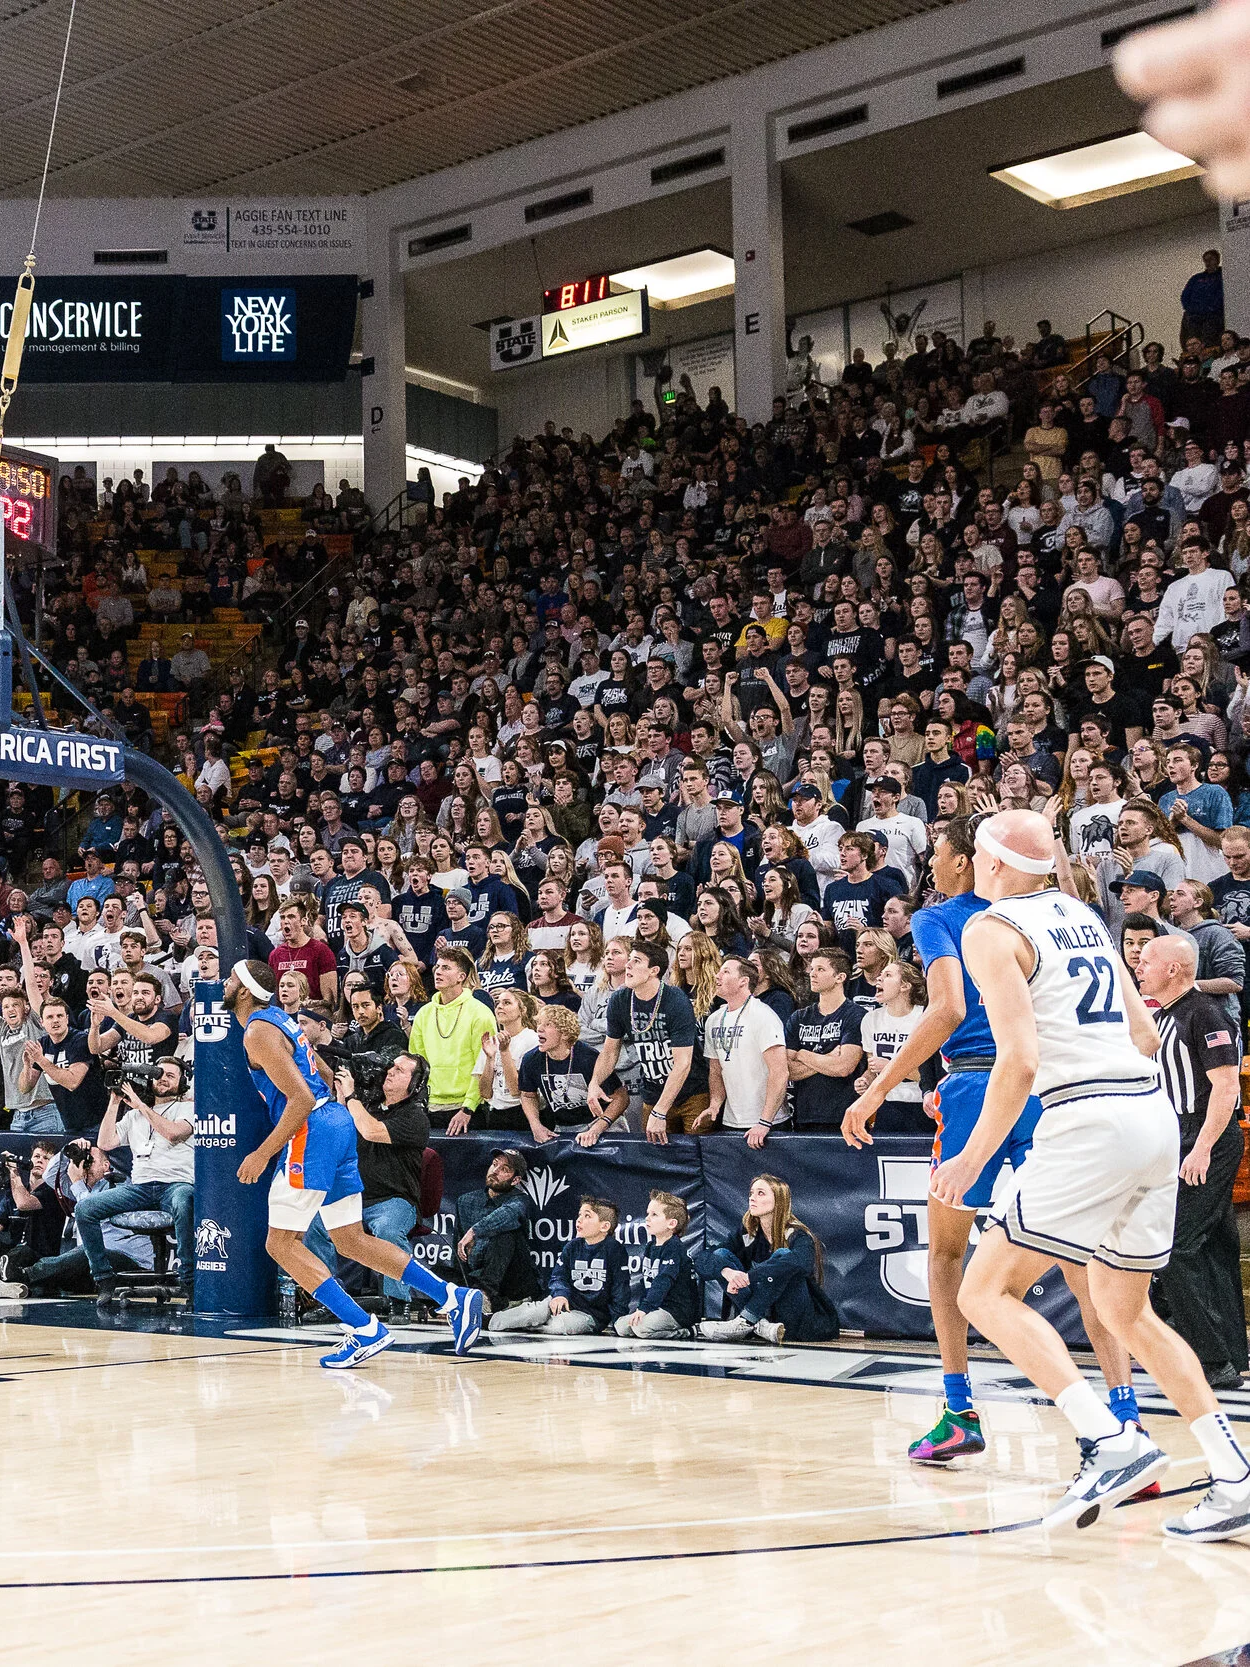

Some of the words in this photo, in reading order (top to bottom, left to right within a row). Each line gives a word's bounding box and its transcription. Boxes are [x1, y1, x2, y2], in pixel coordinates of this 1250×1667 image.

[235, 209, 268, 222] AGGIE
[271, 210, 293, 222] FAN
[296, 210, 323, 222] TEXT
[324, 209, 347, 221] LINE
[252, 224, 331, 235] 435-554-1010
[231, 240, 248, 248] TEXT
[250, 240, 256, 248] IN
[257, 240, 278, 248] GUEST
[280, 240, 316, 248] CONCERNS
[317, 240, 328, 248] OR
[330, 240, 352, 248] ISSUES
[233, 296, 287, 316] NEW
[571, 313, 598, 326] STAKER
[600, 306, 629, 320] PARSON
[225, 314, 292, 334] YORK
[745, 313, 759, 335] E
[29, 343, 98, 354] management
[99, 342, 108, 352] &
[110, 341, 141, 354] billing
[235, 332, 285, 352] LIFE
[496, 332, 537, 353] STATE
[56, 740, 120, 772] FIRST
[1047, 925, 1104, 951] MILLER
[478, 968, 515, 992] State
[1067, 956, 1124, 1026] 22
[194, 1014, 231, 1028] STATE
[873, 1033, 896, 1043] UTAH
[634, 1040, 672, 1062] TRUE
[196, 1260, 226, 1271] AGGIES
[571, 1269, 607, 1283] STATE
